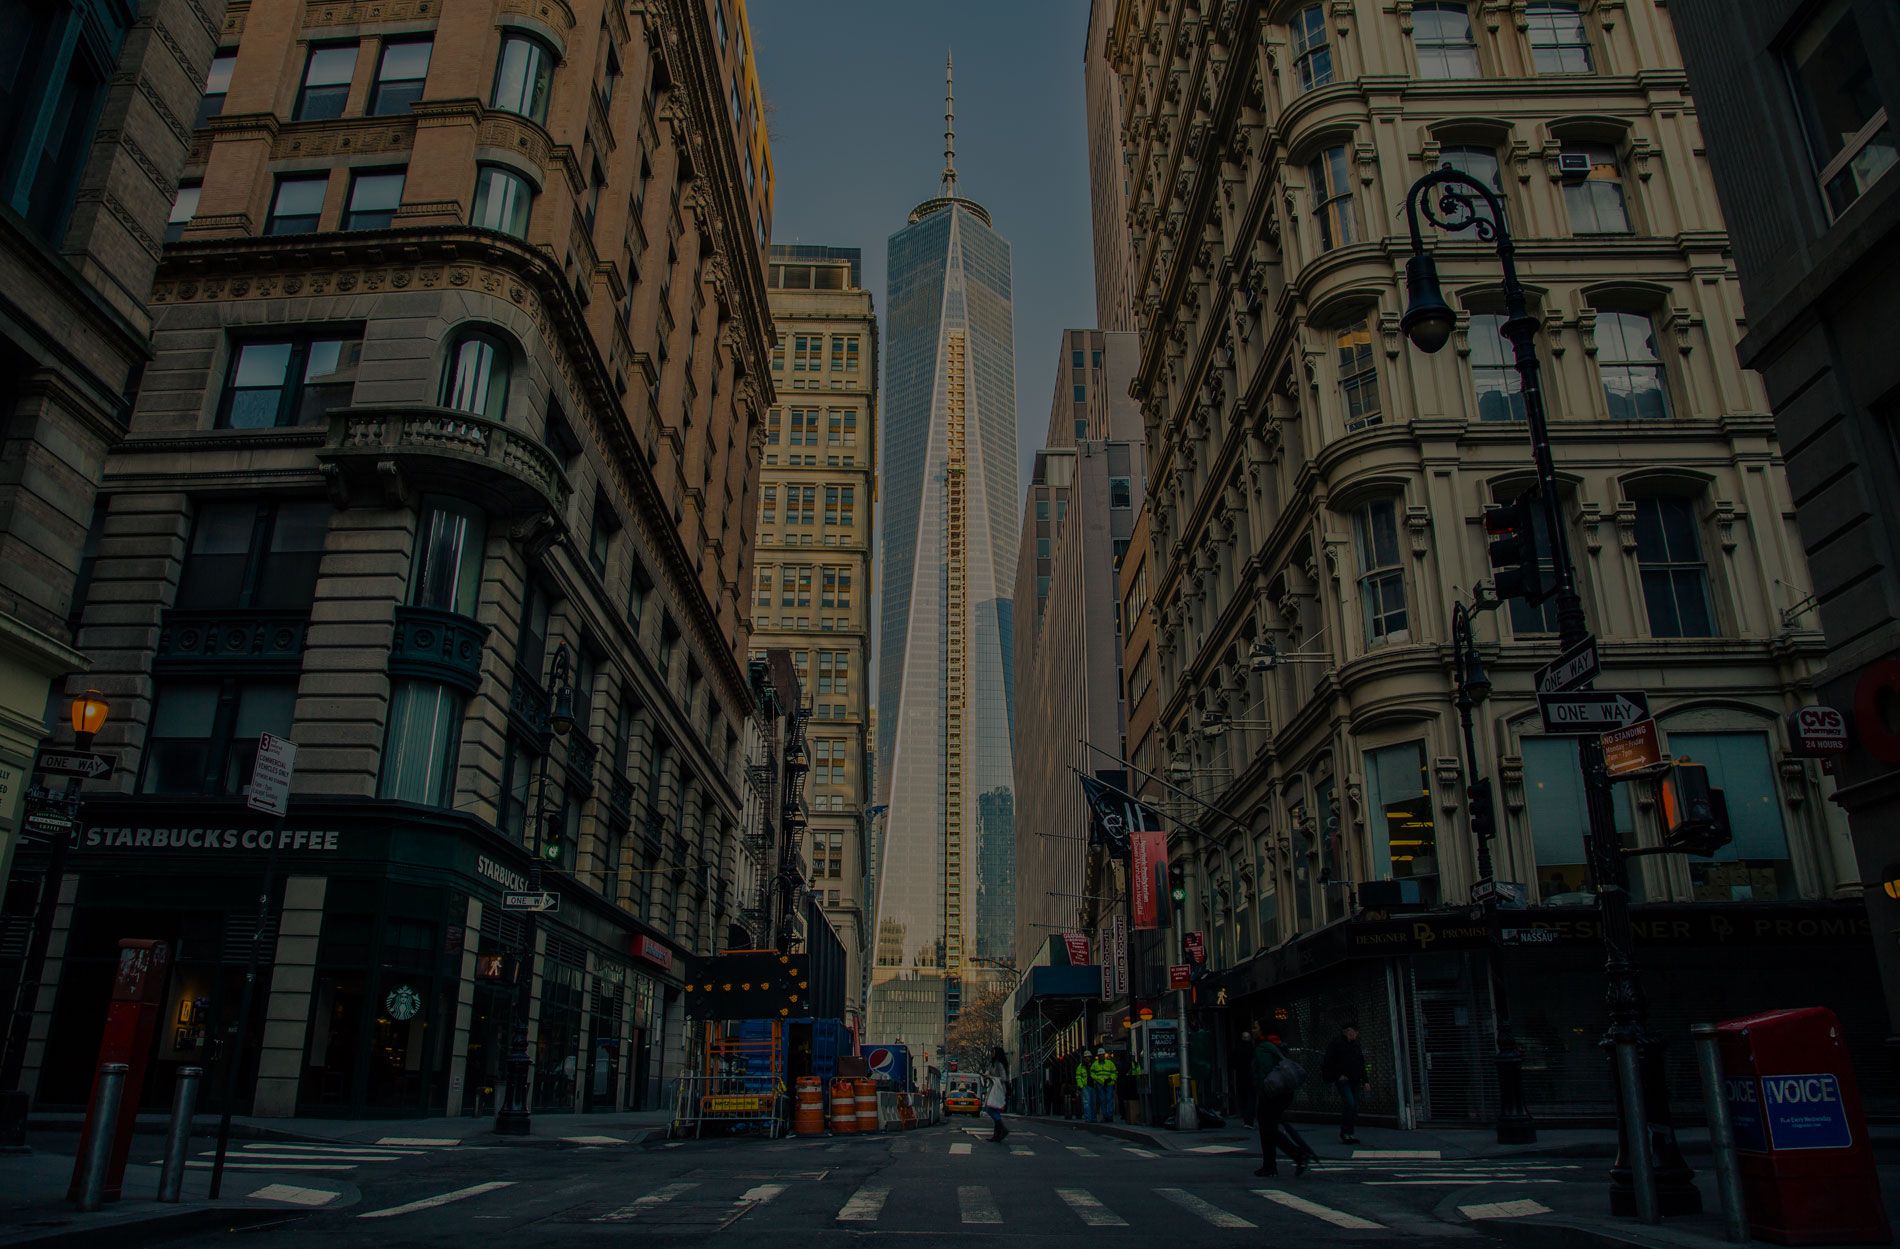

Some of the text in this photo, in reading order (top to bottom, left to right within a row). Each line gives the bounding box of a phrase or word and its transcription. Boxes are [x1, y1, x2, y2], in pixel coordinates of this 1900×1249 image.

[1544, 652, 1589, 692] ONE WAY
[1557, 704, 1632, 720] ONE WAY
[1800, 711, 1840, 727] CVS
[262, 735, 269, 750] 3
[1604, 726, 1647, 745] NO STANDING
[46, 757, 102, 771] ONE WAY
[86, 827, 340, 850] STARBUCKS COFFEE
[477, 855, 525, 892] STARBUCKS
[1356, 933, 1408, 944] DESIGNER
[1520, 933, 1553, 942] NASSAU
[1724, 1080, 1757, 1103] OICE
[1769, 1078, 1836, 1104] VOICE
